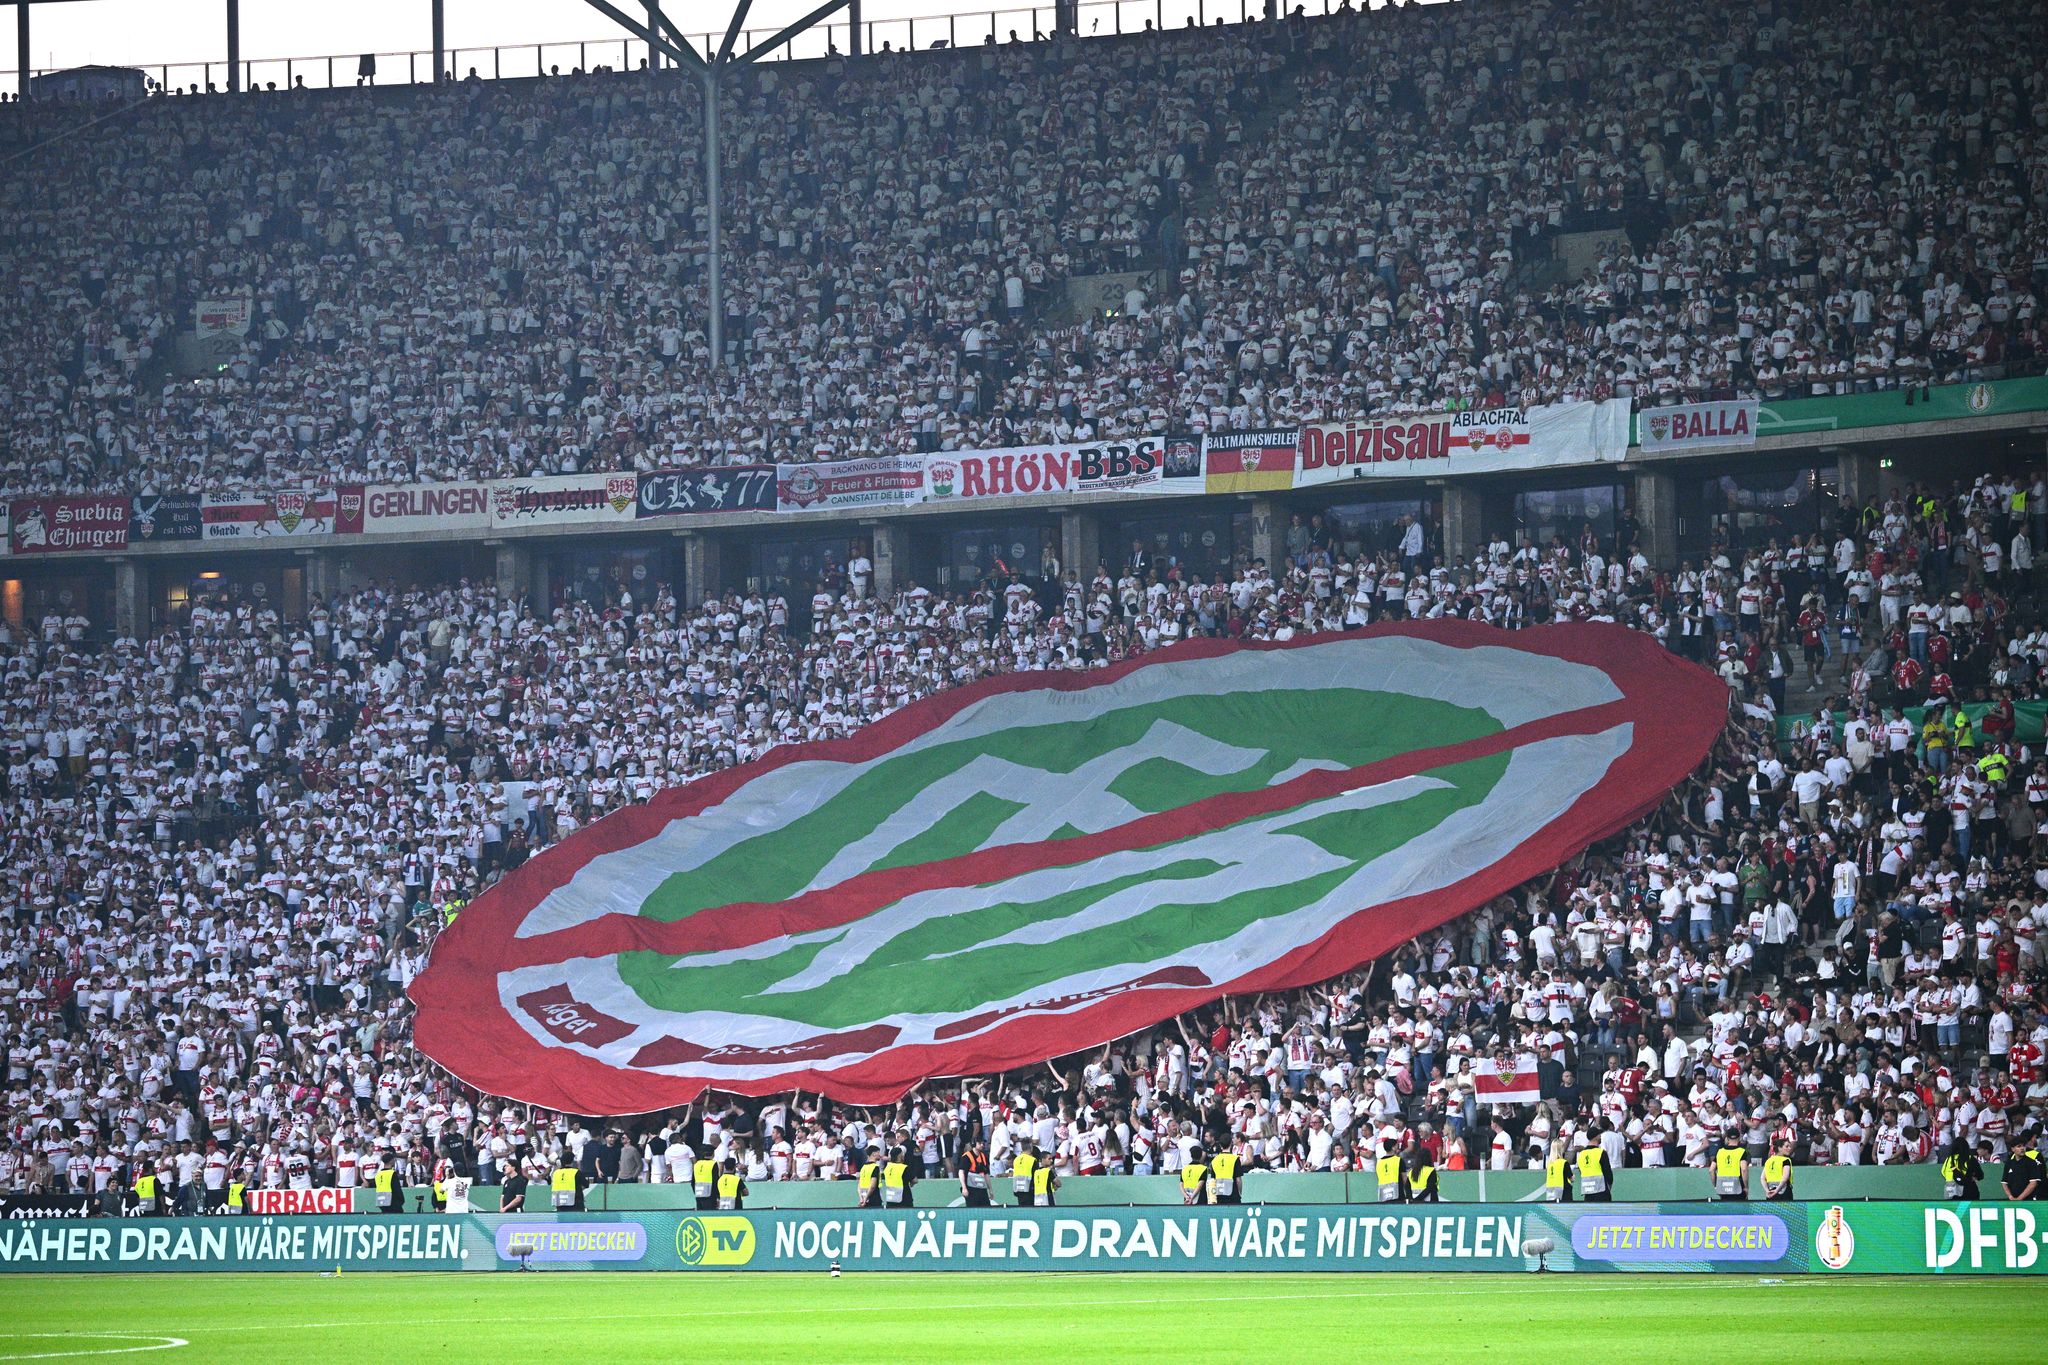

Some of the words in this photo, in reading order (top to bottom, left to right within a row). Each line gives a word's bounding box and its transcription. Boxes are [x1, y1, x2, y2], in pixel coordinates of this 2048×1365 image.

[1102, 283, 1125, 299] 23
[1452, 410, 1529, 427] ABLACHTAL
[1672, 409, 1749, 440] BALLA
[1207, 432, 1297, 449] BALTMANNSWEILER
[1302, 421, 1452, 470] Deizisau
[831, 462, 877, 475] BACKNANG
[878, 461, 892, 469] DIE
[1078, 441, 1156, 481] BBS
[831, 480, 861, 492] Feuer
[864, 477, 872, 488] &
[874, 476, 917, 487] Flamme
[960, 451, 1071, 497] RHÖN
[641, 474, 696, 511] CK
[734, 470, 774, 506] 77
[831, 493, 879, 505] CANNSTATT
[55, 503, 123, 524] Suebia
[368, 488, 488, 518] GERLINGEN
[49, 527, 127, 548] Ehingen
[210, 525, 241, 536] Garde
[1623, 1070, 1633, 1087] 8
[1088, 1142, 1097, 1157] 8
[247, 1189, 352, 1214] URBACH
[119, 1228, 227, 1261] DRAN
[235, 1218, 306, 1259] WÄRE
[312, 1224, 469, 1259] MITSPIELEN.
[509, 1232, 547, 1251] JETZT
[549, 1231, 637, 1251] ENTDECKEN
[712, 1230, 747, 1251] TV
[774, 1220, 862, 1259] NOCH
[872, 1210, 1040, 1258] NÄHER
[1052, 1218, 1199, 1258] DRAN
[1210, 1207, 1306, 1258] WÄRE
[1587, 1226, 1645, 1249] JETZT
[1649, 1226, 1773, 1249] ENTDECKEN
